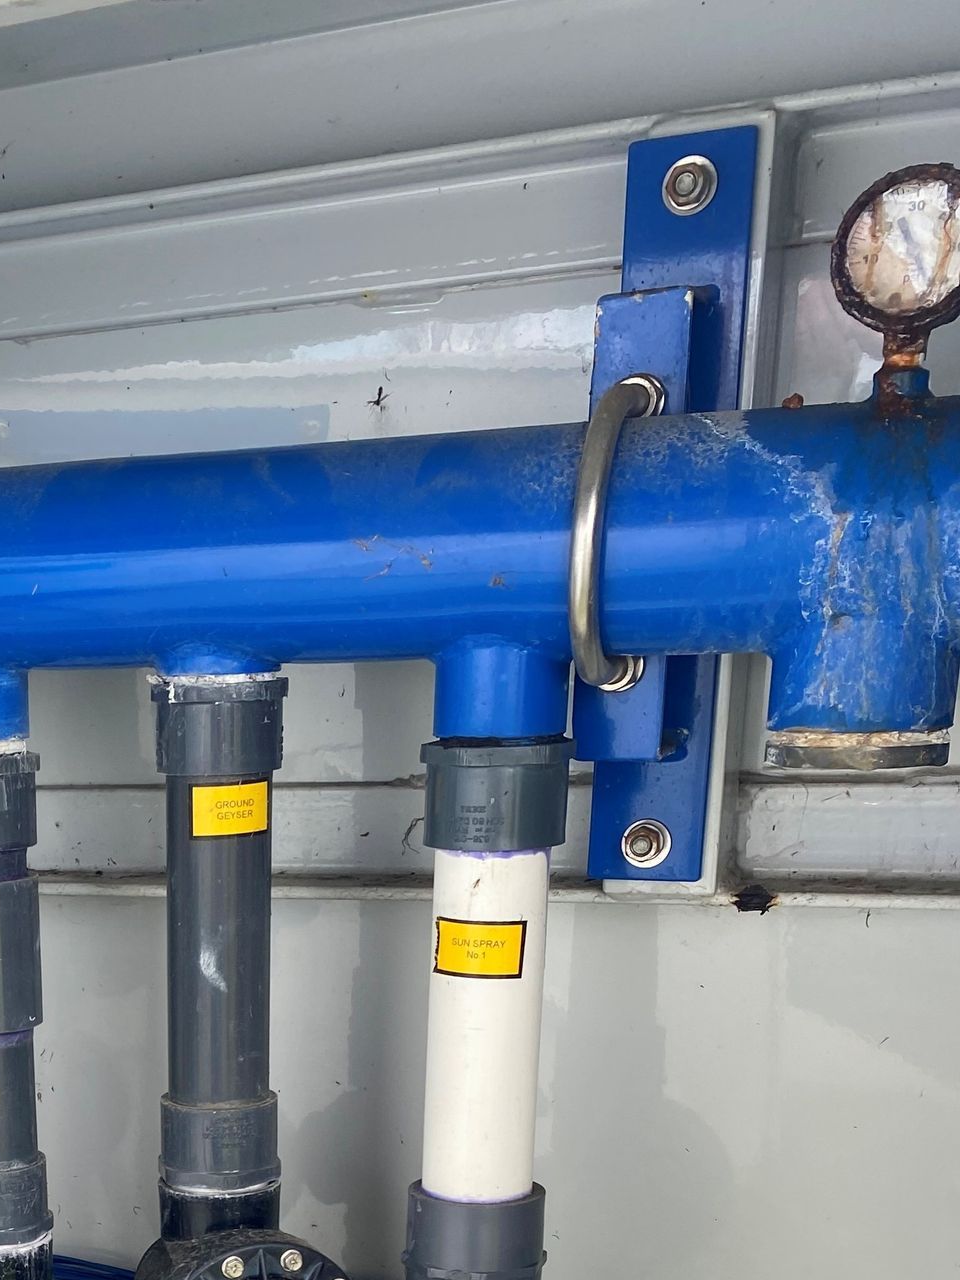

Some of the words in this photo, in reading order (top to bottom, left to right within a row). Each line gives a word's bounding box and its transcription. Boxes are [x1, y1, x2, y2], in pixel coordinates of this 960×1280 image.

[908, 200, 925, 211] 30
[215, 799, 255, 809] GROUND
[216, 810, 253, 820] GEYSER
[451, 937, 471, 948] SUN
[473, 940, 506, 949] SPRAY
